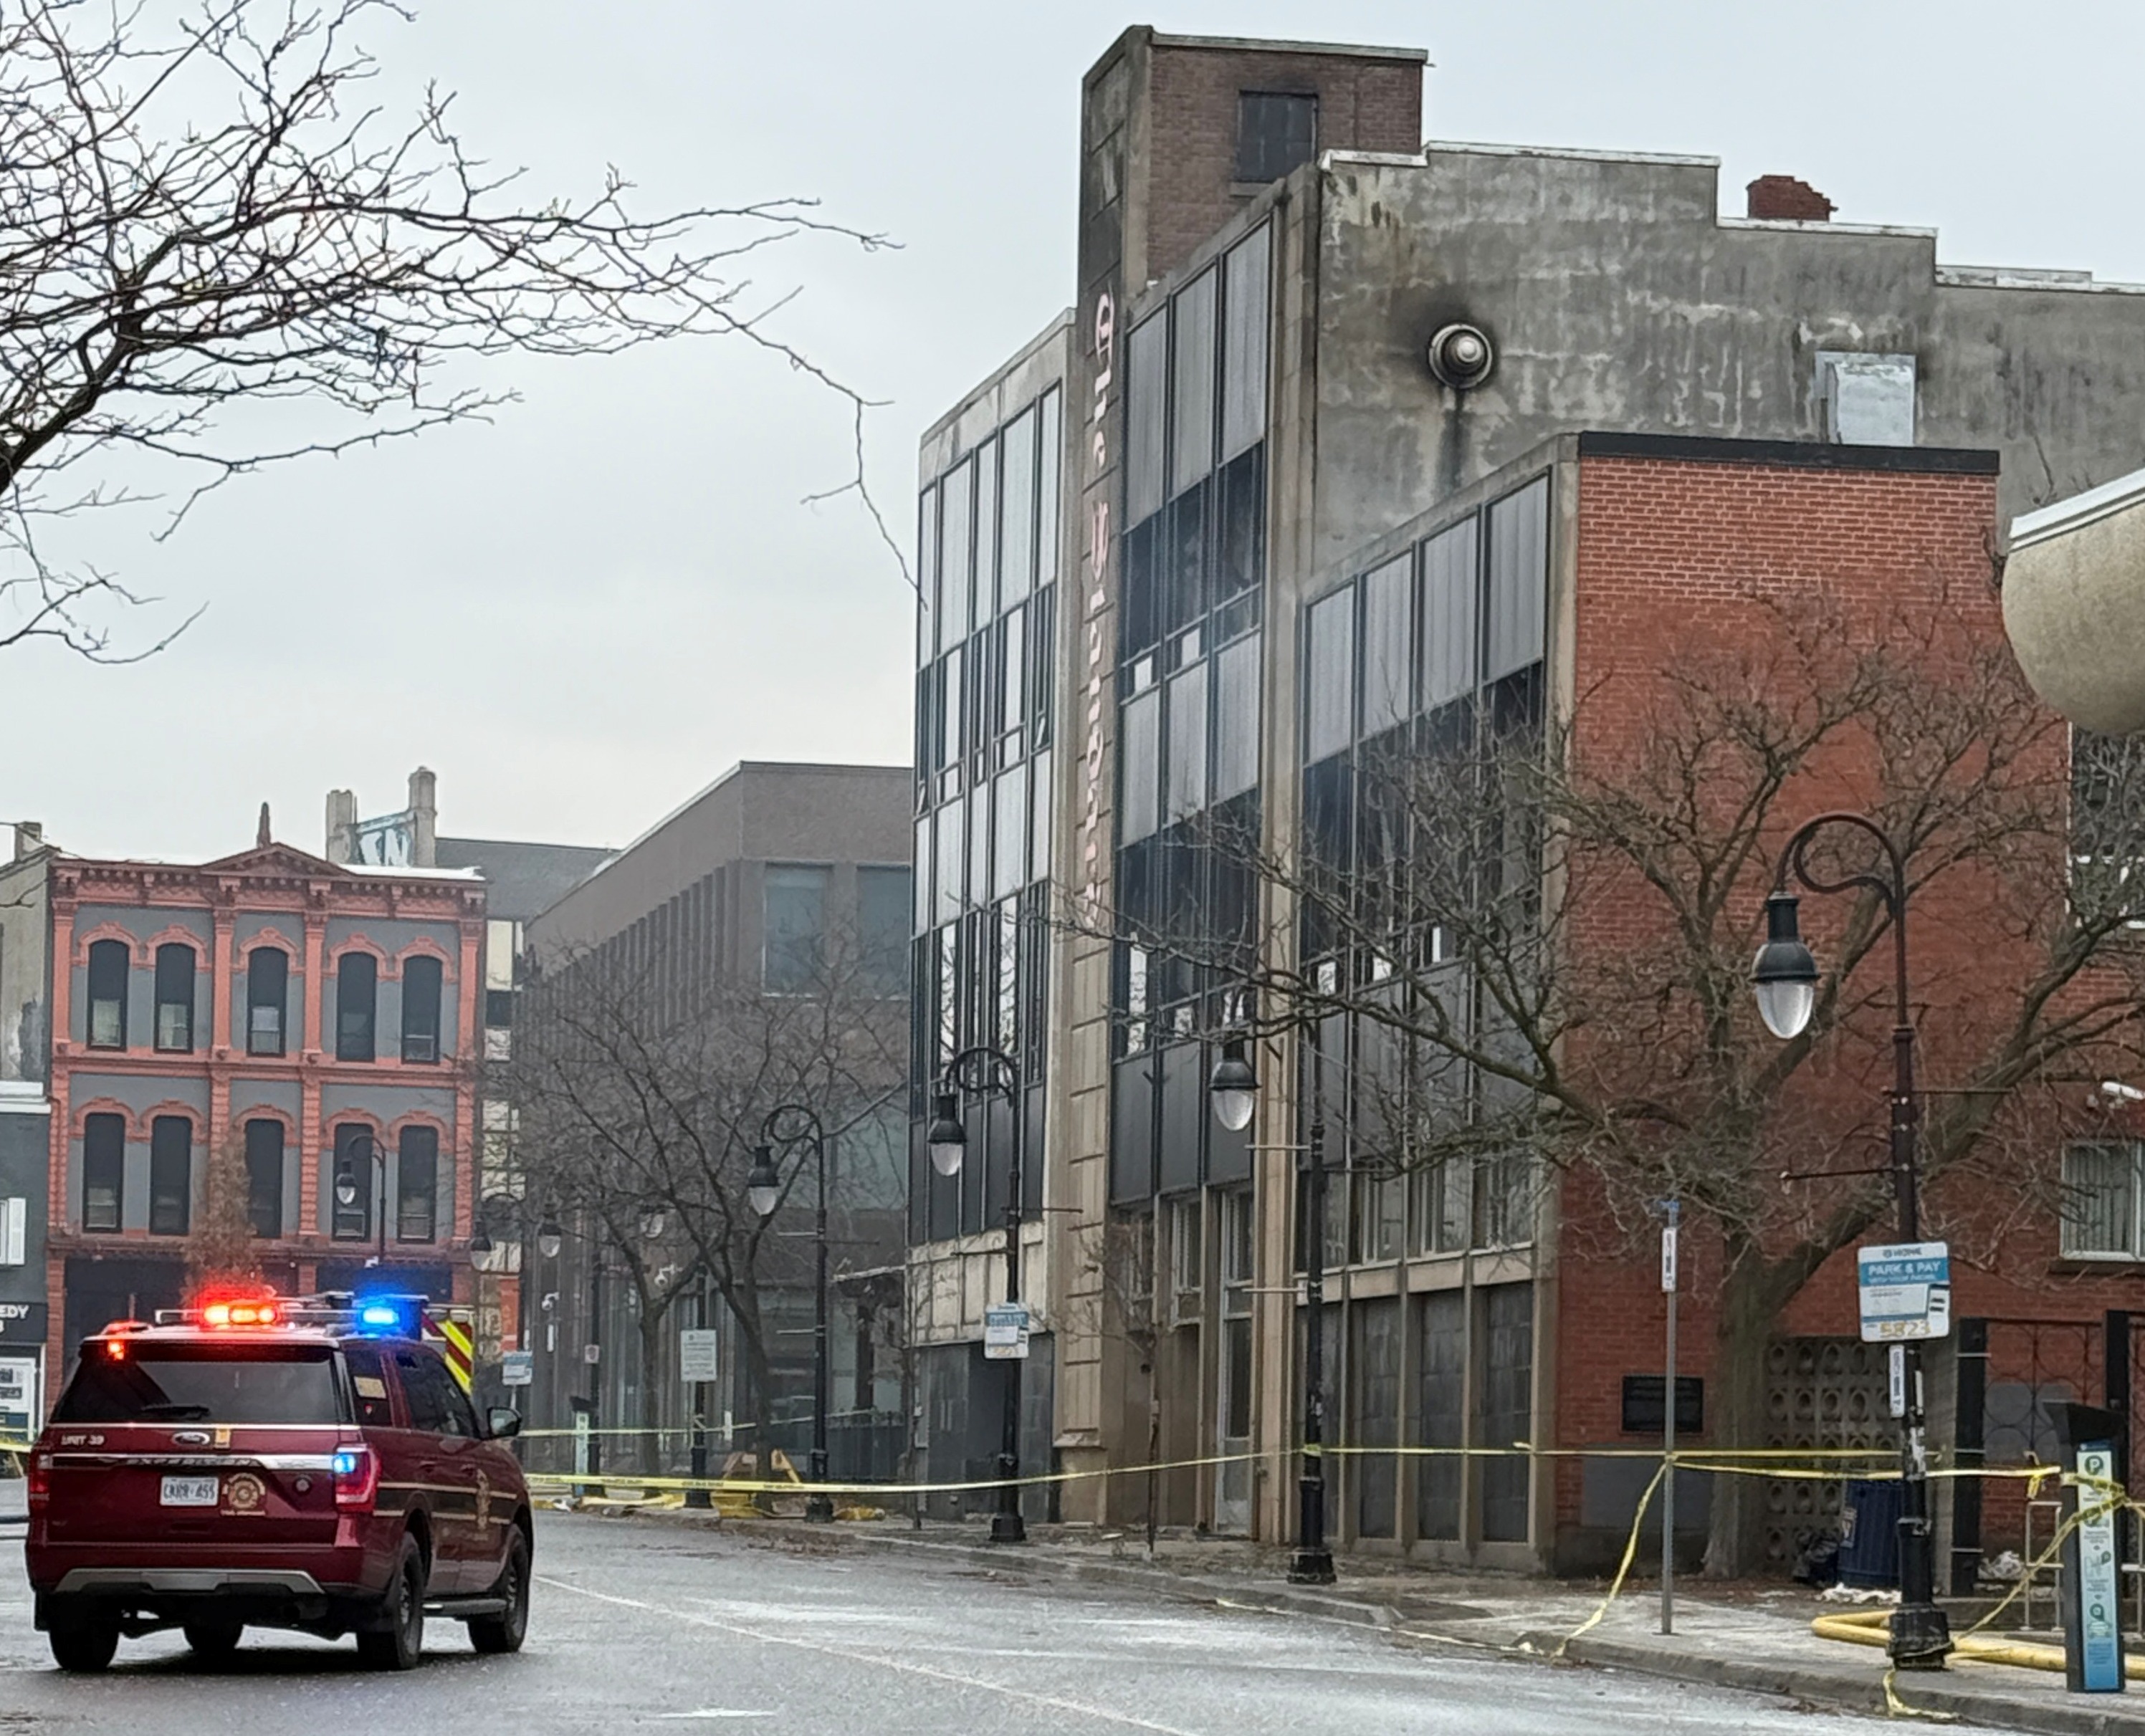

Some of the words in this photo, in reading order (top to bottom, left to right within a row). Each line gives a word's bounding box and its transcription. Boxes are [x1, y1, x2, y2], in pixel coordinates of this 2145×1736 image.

[1093, 287, 1115, 469] The
[1868, 1263, 1901, 1276] PARK
[1905, 1262, 1914, 1274] &
[1916, 1260, 1941, 1272] PAY
